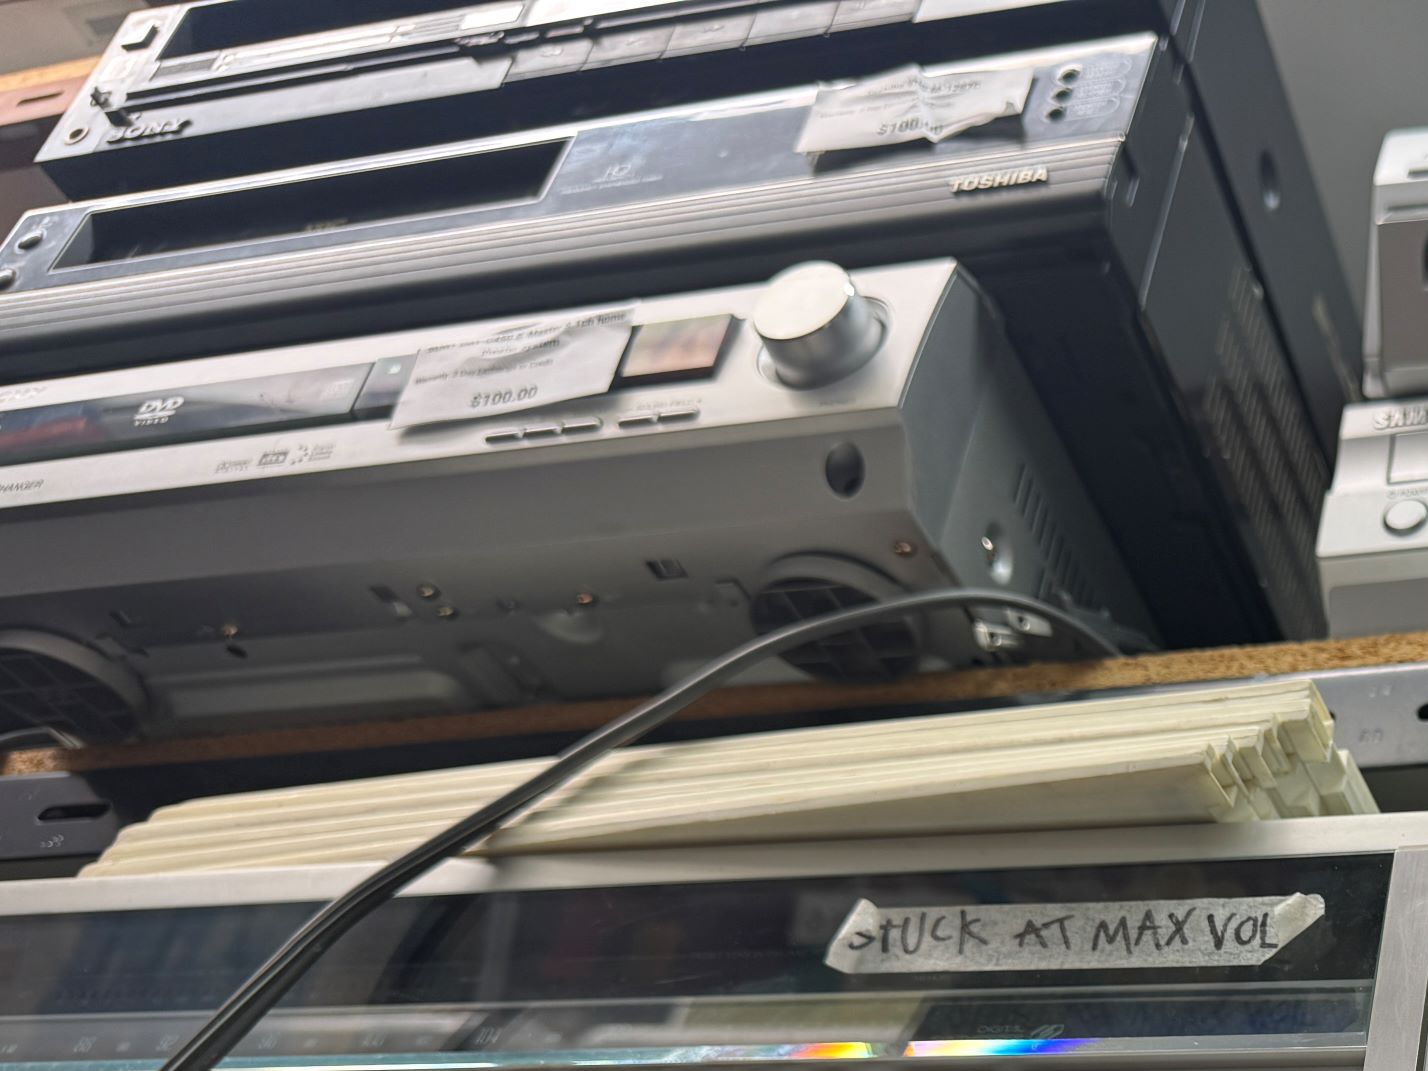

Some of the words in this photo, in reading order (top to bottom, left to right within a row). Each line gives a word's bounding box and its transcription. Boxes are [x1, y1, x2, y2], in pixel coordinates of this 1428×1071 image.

[950, 167, 1048, 193] TOSHIBA
[138, 396, 185, 414] DVD
[1013, 912, 1075, 951] AT
[1092, 905, 1198, 957] MAX
[1206, 910, 1280, 953] VOL
